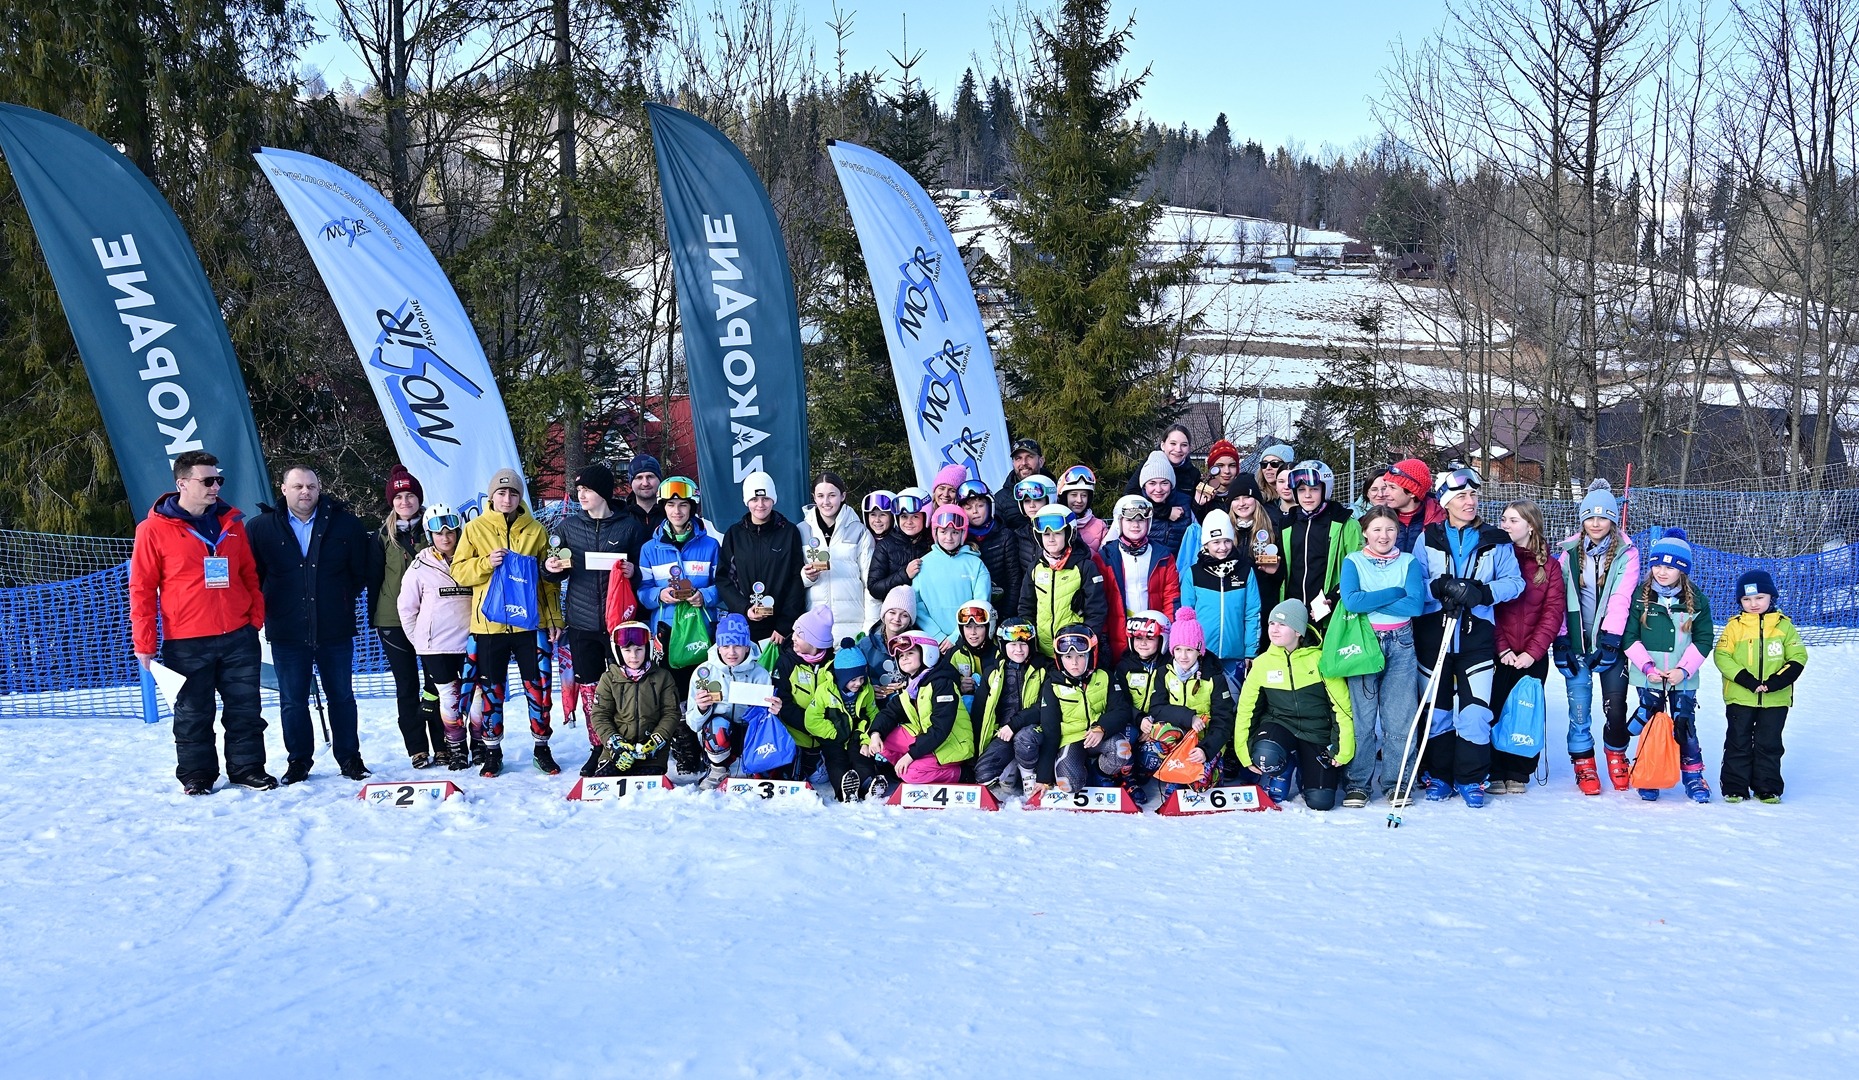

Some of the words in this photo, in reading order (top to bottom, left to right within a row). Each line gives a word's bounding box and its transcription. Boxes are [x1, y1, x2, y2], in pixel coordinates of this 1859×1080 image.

[932, 253, 943, 283] ZAKOPANE
[410, 299, 437, 348] ZAKOPANE
[960, 345, 973, 376] ZAKOPANE
[369, 308, 484, 446] MOSiR
[941, 427, 984, 486] SiR
[977, 432, 991, 463] ZAKOPANE
[1126, 619, 1156, 633] VOLA
[395, 786, 415, 805] 2
[617, 778, 628, 797] 1
[758, 781, 775, 799] 3
[933, 788, 949, 806] 4
[1073, 789, 1090, 807] 5
[1210, 790, 1227, 808] 6
